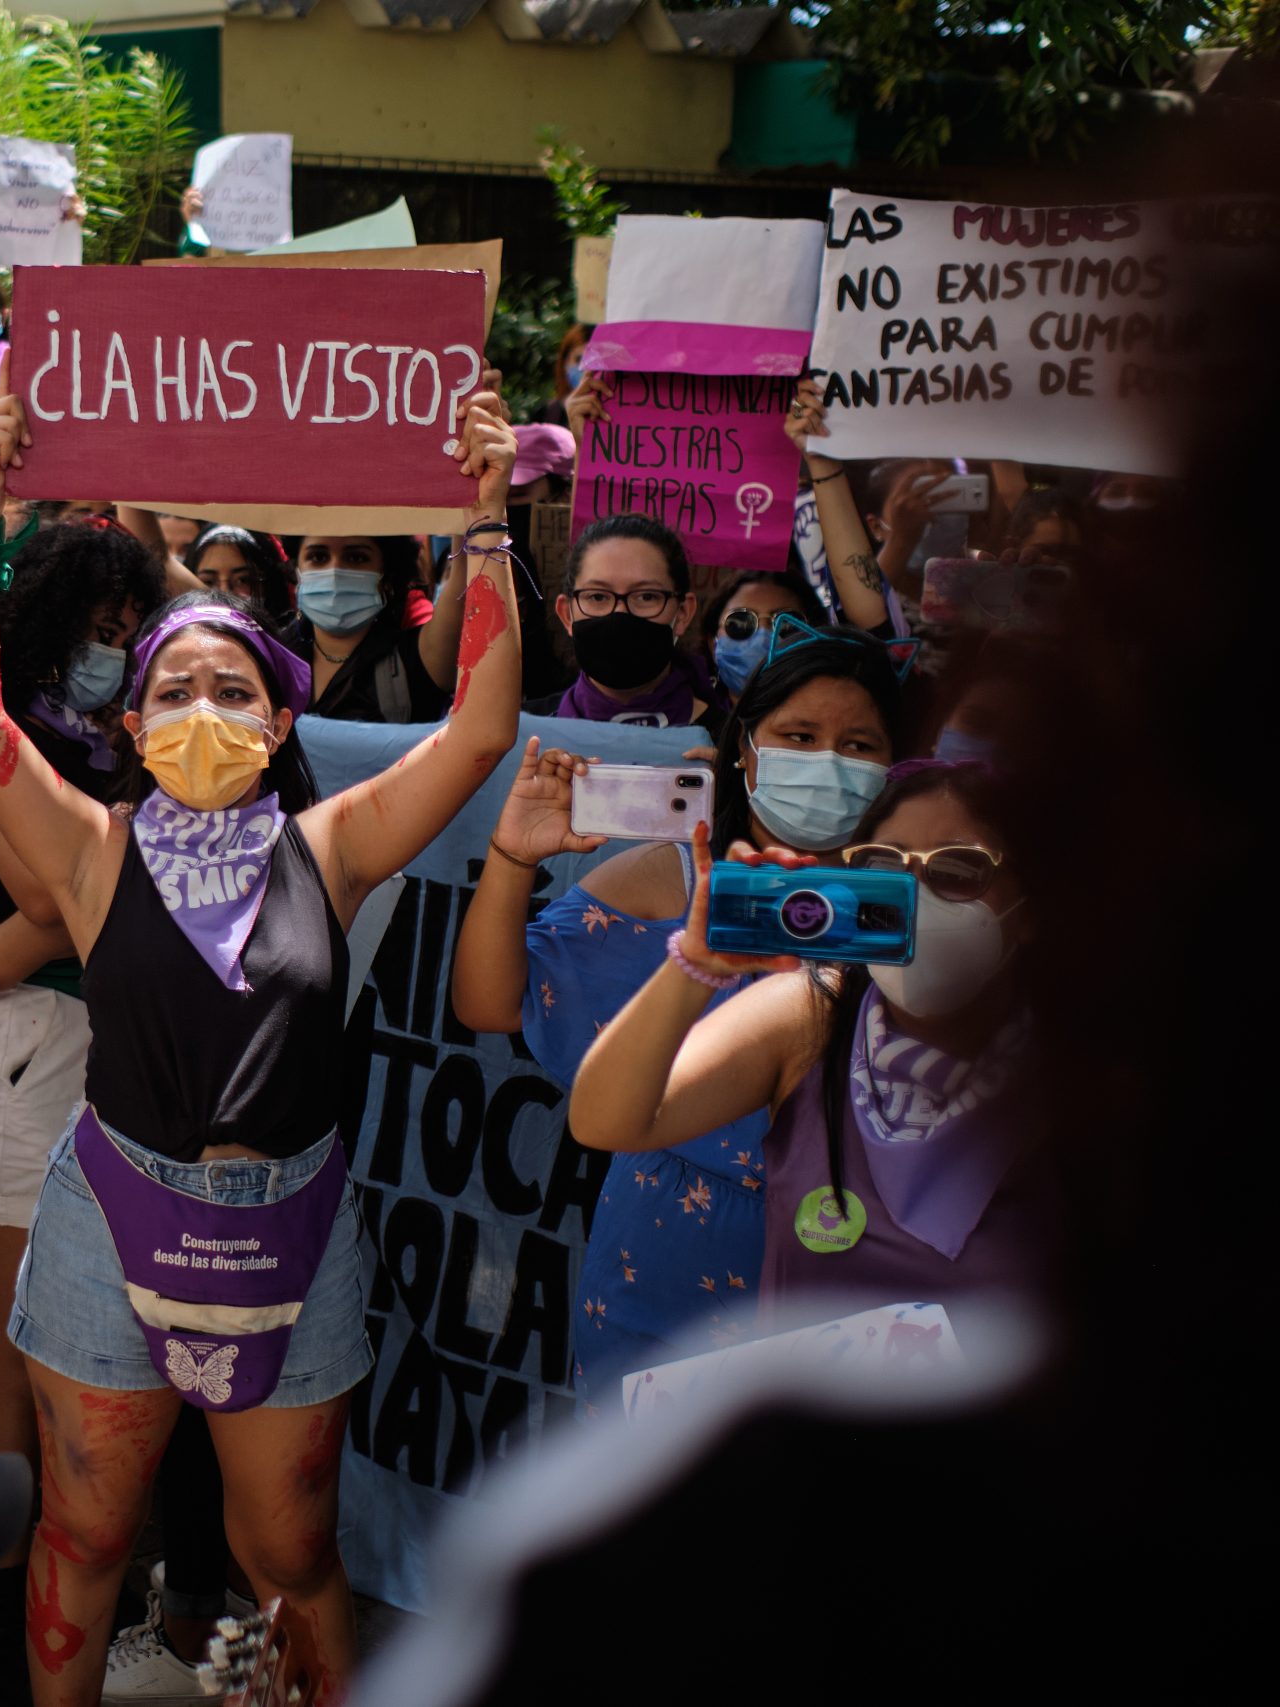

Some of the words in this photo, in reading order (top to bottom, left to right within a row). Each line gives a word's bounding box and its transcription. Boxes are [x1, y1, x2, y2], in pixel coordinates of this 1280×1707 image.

[826, 203, 903, 248] LAS
[953, 204, 1141, 247] MUJERES
[837, 264, 901, 312] NO
[937, 255, 1169, 304] EXISTIMOS
[881, 315, 997, 360] PARA
[30, 309, 139, 424] ¿LA
[155, 336, 258, 424] HAS
[278, 341, 480, 456] VISTO?
[1040, 356, 1095, 396] DE
[591, 423, 743, 474] NUESTRAS
[153, 1249, 188, 1268] desde
[191, 1252, 209, 1269] las
[212, 1254, 279, 1271] diversidades
[181, 1232, 261, 1254] Construyendo
[354, 1185, 569, 1385] IOLA
